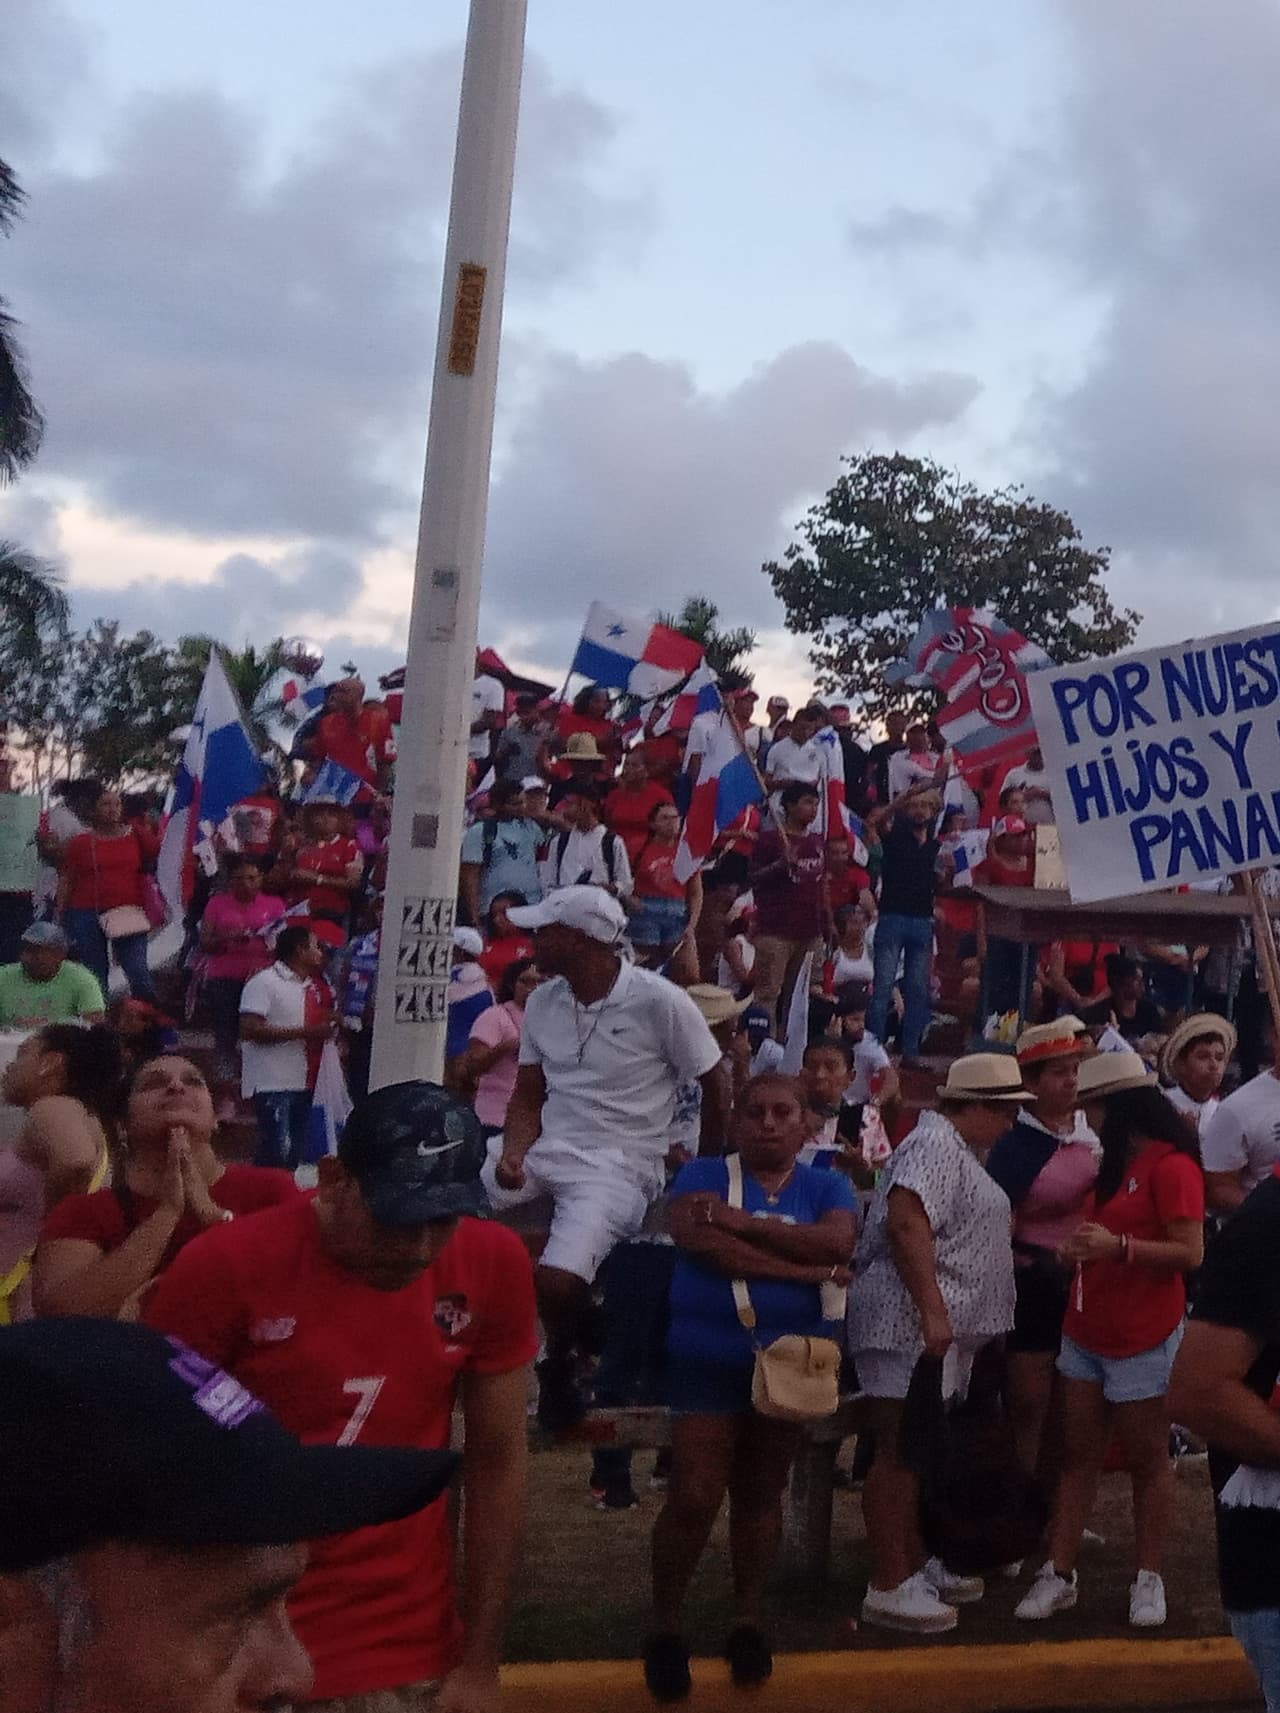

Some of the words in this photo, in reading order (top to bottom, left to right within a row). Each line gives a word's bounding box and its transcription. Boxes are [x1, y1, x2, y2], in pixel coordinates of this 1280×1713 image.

[1050, 661, 1157, 746] POR
[1209, 720, 1253, 789] Y
[402, 899, 453, 934] ZKE
[398, 940, 449, 976] ZKE
[395, 984, 446, 1021] ZKE
[336, 1375, 387, 1447] 7
